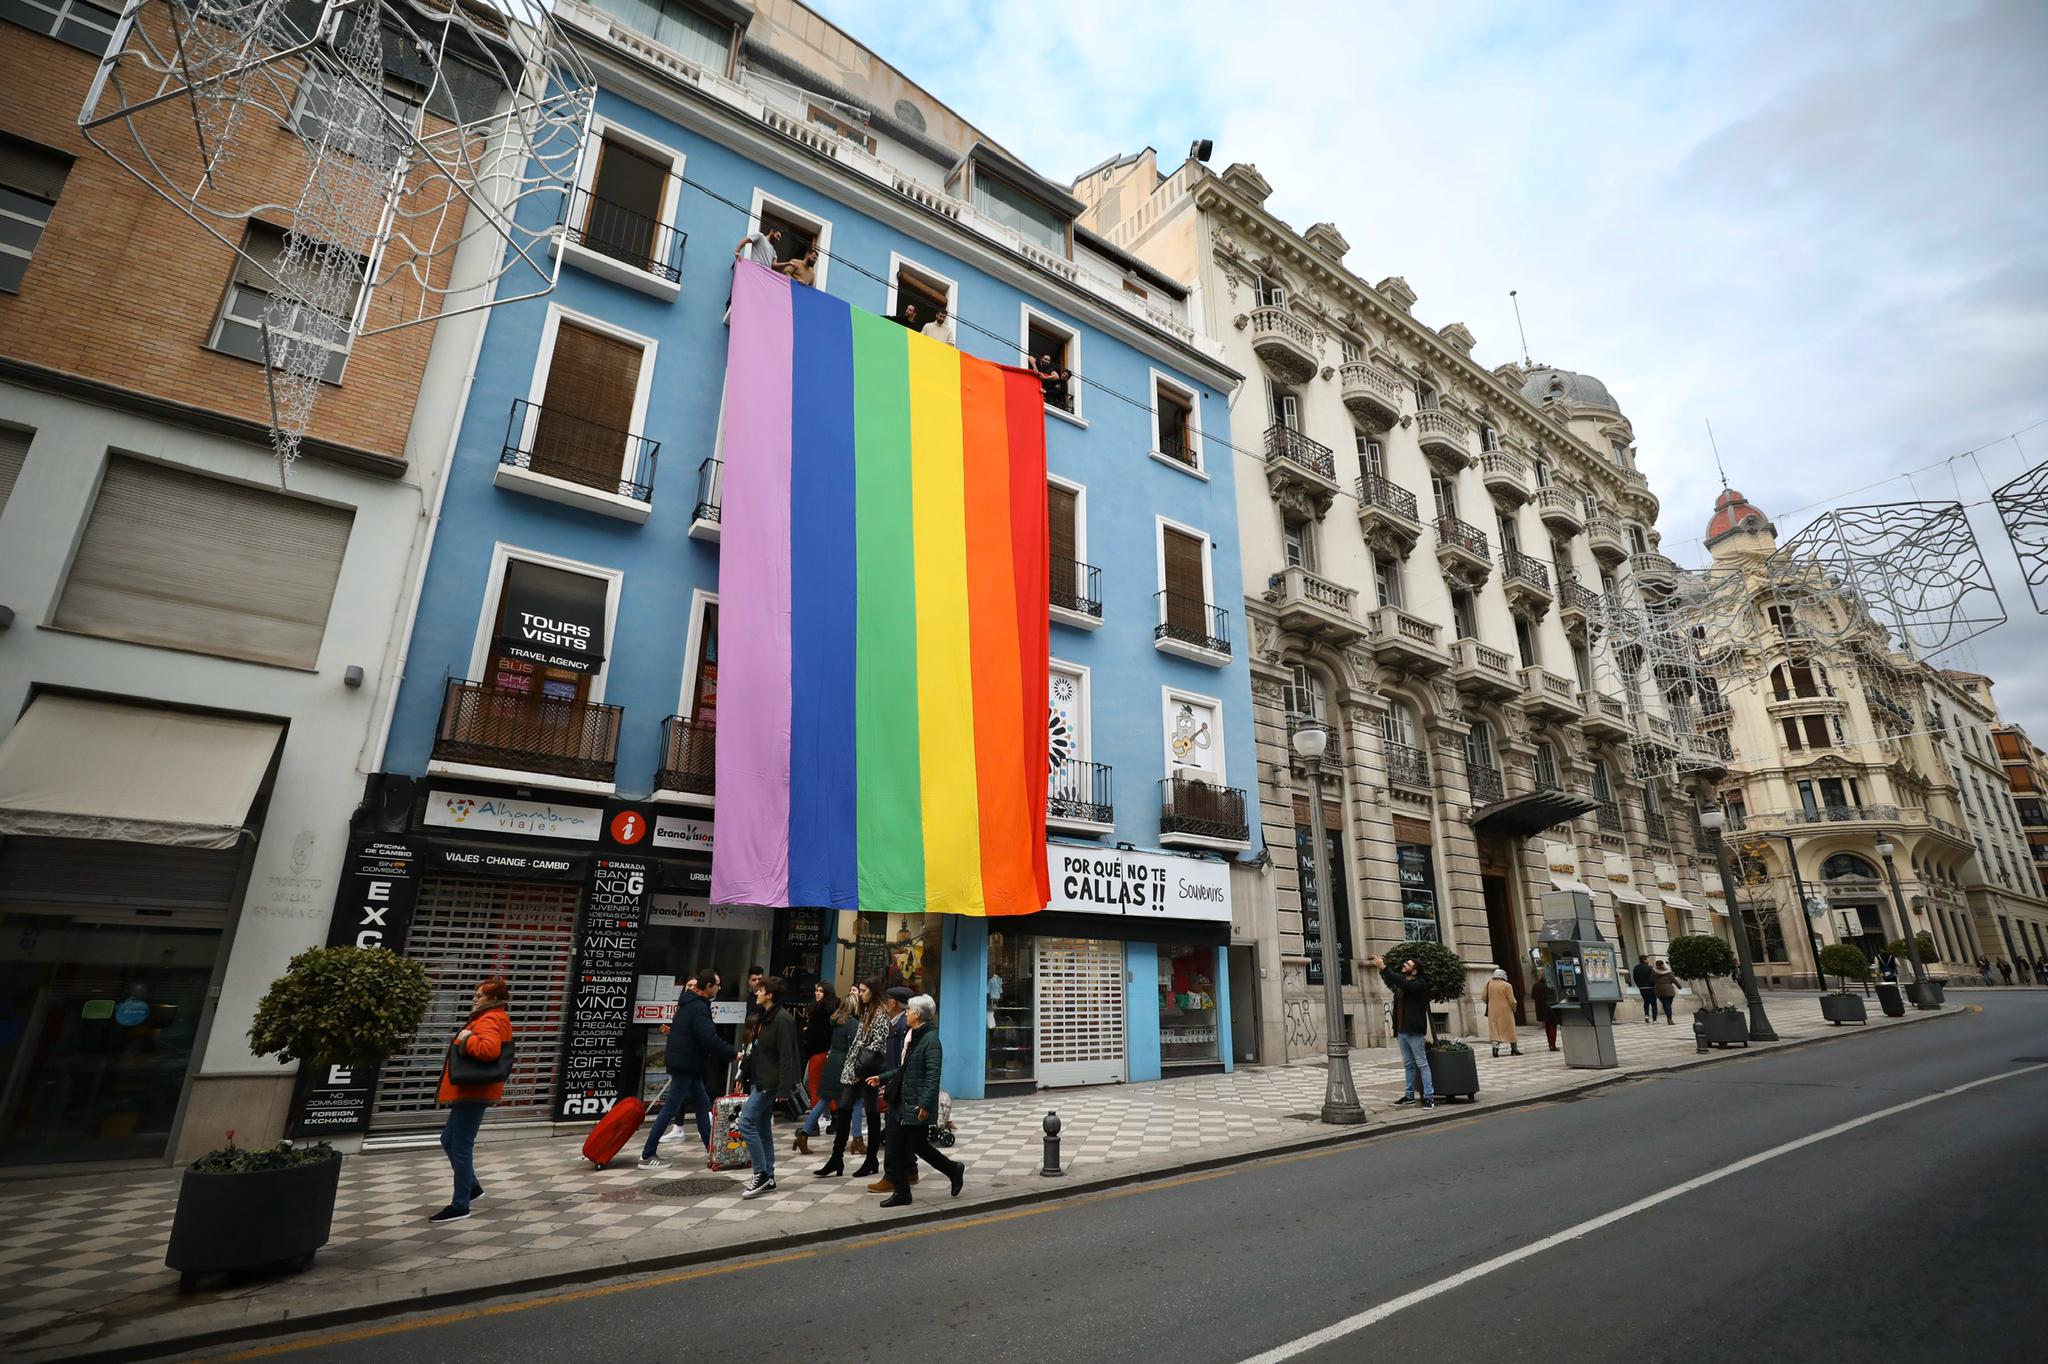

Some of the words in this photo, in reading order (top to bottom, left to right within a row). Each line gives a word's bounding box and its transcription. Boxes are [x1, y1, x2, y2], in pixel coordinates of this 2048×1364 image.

[520, 612, 591, 638] TOURS
[522, 627, 587, 650] VISITS
[498, 659, 533, 673] BUS
[510, 647, 548, 662] TRAVEL
[548, 656, 589, 670] AGENCY
[478, 801, 584, 825] Alhambra
[499, 818, 559, 832] viajes
[379, 849, 413, 857] CAMBIO
[445, 852, 480, 863] VIAJES
[486, 855, 527, 867] CHANGE
[532, 860, 570, 870] CAMBIO
[608, 861, 646, 871] GRANADA
[1064, 857, 1090, 876] POR
[1094, 858, 1121, 878] QUÉ
[1128, 864, 1148, 881] NO
[1151, 868, 1166, 882] TE
[1064, 876, 1146, 907] CALLAS
[1178, 878, 1224, 903] Souvenirs
[592, 975, 632, 983] ALHAMBRA
[577, 996, 627, 1009] VINO
[598, 1080, 616, 1088] OIL
[304, 1117, 359, 1125] EXCHANGE
